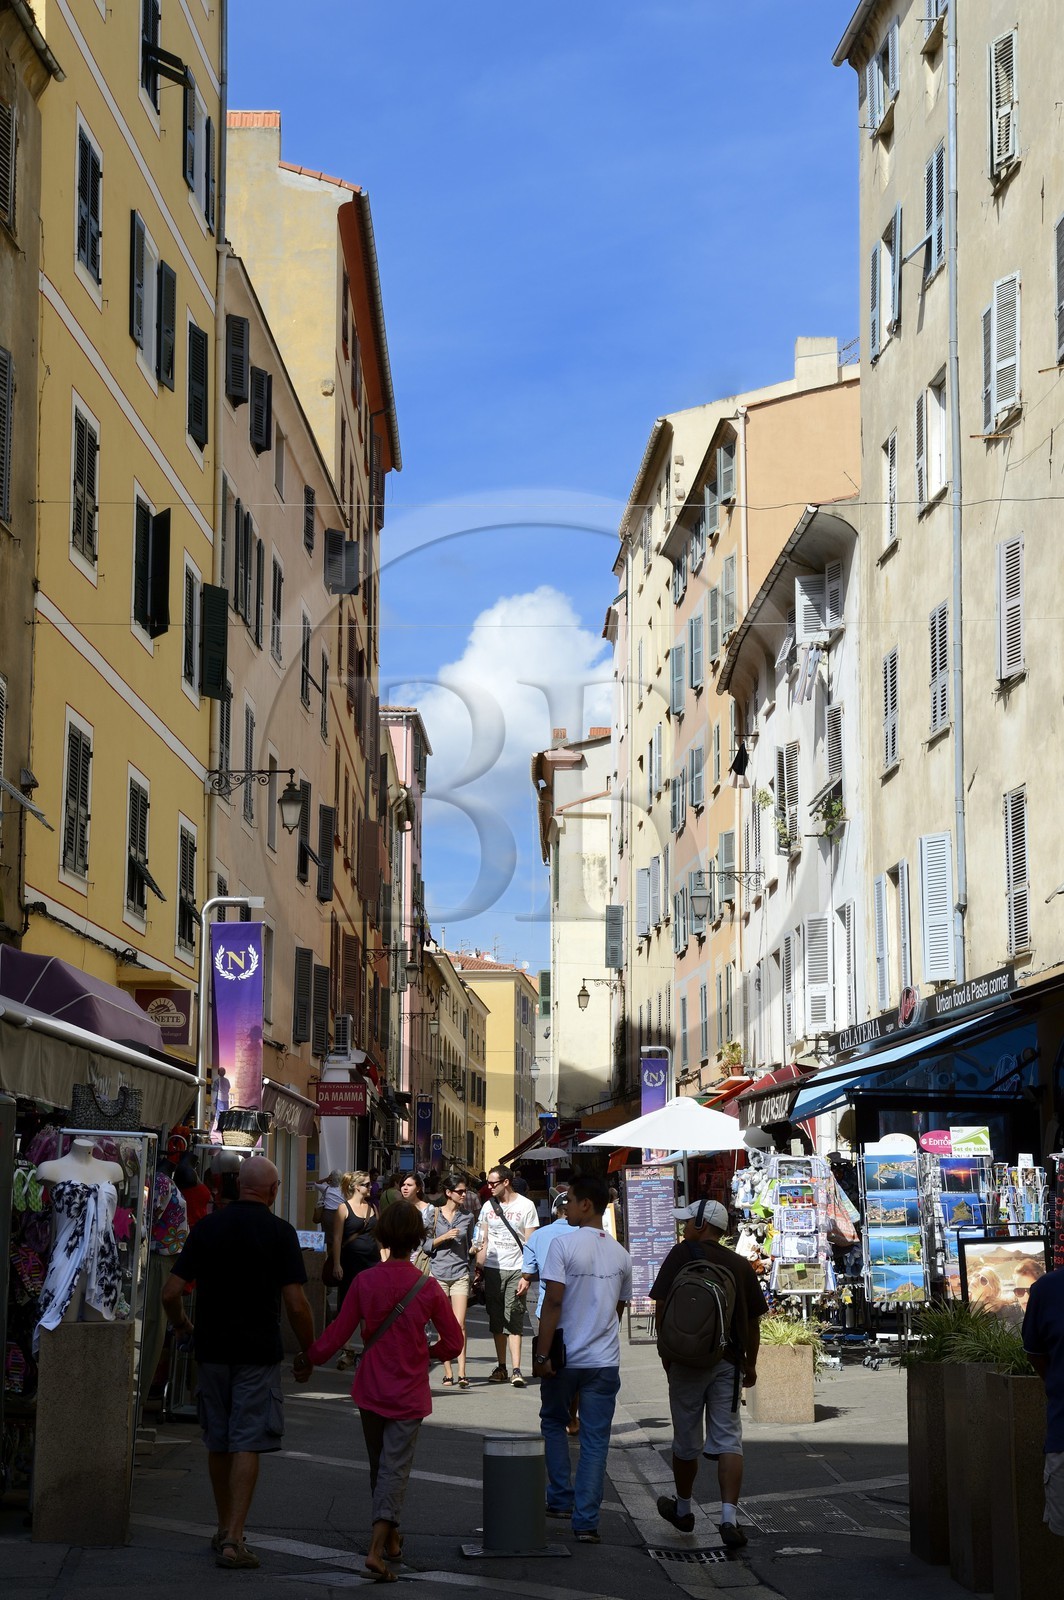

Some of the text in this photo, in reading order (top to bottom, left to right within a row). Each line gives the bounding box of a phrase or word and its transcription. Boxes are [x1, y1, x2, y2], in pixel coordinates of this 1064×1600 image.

[226, 951, 246, 970] N
[935, 993, 953, 1013] Urban
[952, 985, 966, 1008] food
[966, 985, 971, 1003] &
[971, 979, 989, 1001] Pasta
[989, 973, 1009, 995] corner
[839, 1018, 881, 1051] GELATERIA
[649, 1072, 659, 1082] N
[318, 1092, 364, 1101] DA MAMMA
